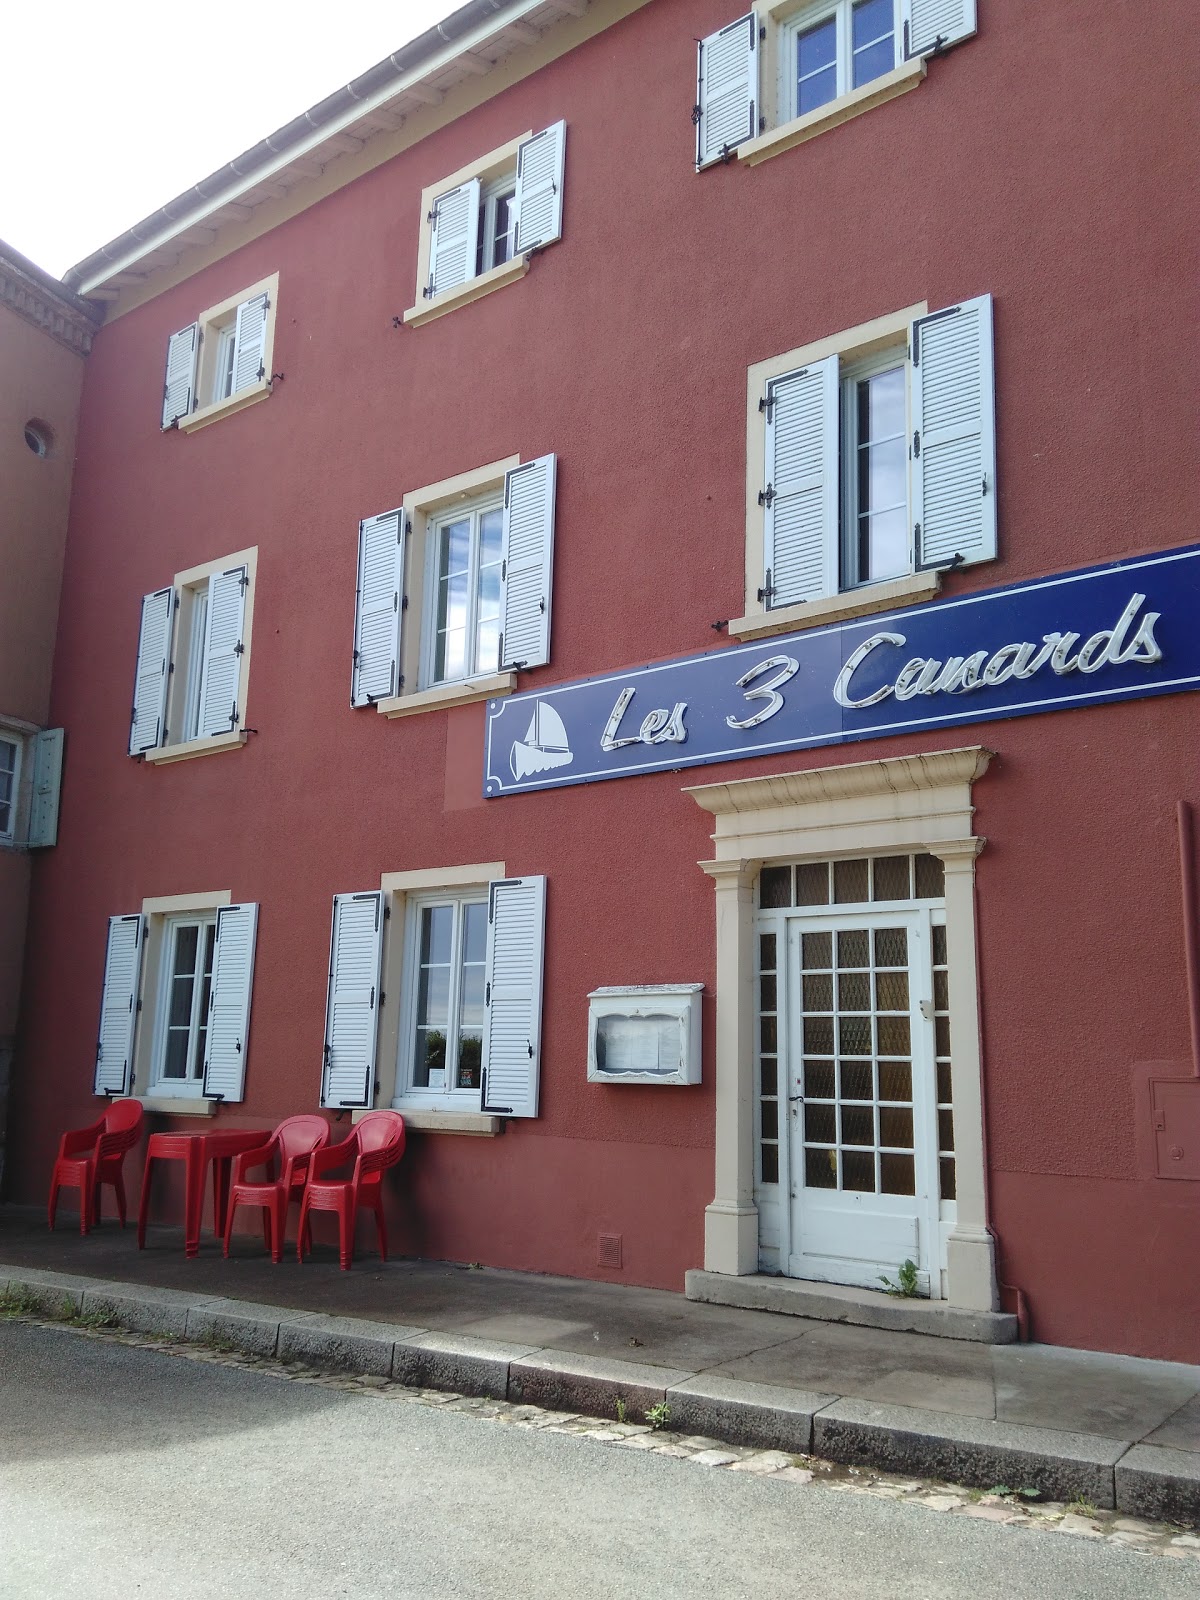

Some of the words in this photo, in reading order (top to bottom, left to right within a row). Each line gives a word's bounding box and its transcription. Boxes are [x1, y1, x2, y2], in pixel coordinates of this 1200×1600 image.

[600, 687, 689, 752] Les
[726, 654, 800, 729] 3
[833, 592, 1163, 709] Canards
